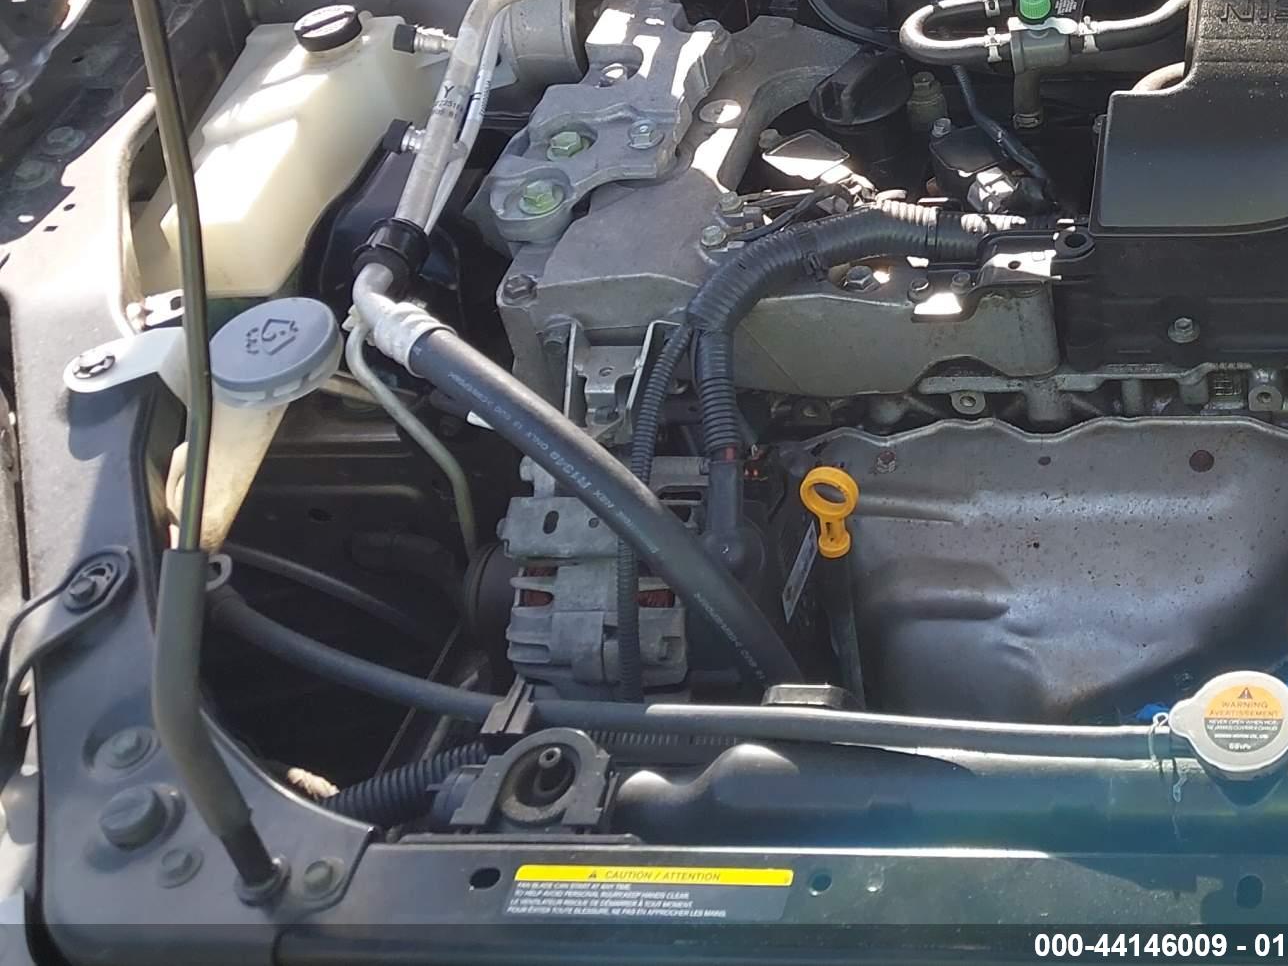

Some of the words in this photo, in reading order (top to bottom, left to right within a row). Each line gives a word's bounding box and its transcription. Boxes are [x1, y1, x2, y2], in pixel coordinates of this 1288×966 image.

[1222, 701, 1269, 709] WARNING
[1208, 709, 1279, 717] AVERTISSEMENT
[604, 870, 652, 880] CAUTION
[663, 871, 721, 881] ATTENTION
